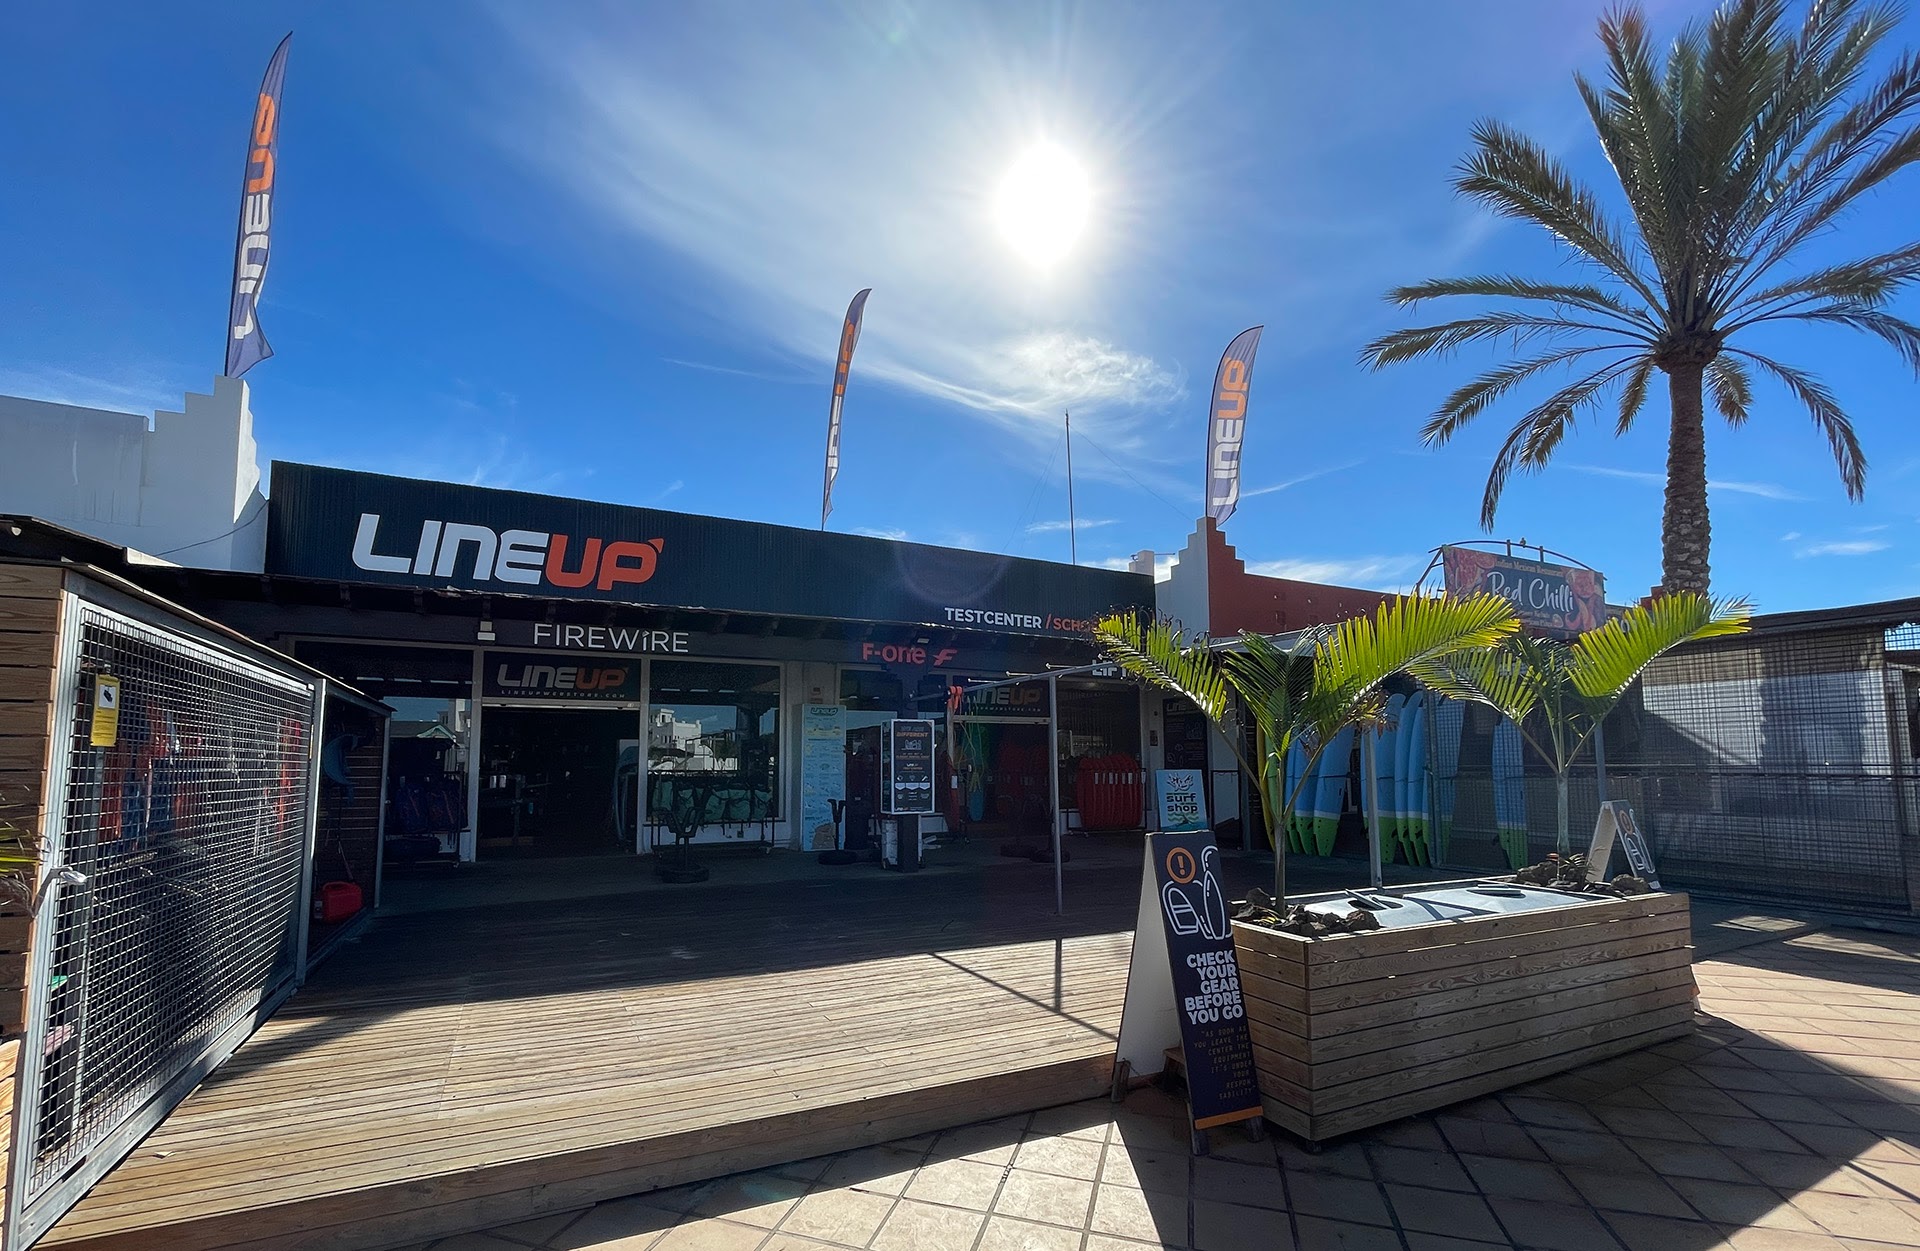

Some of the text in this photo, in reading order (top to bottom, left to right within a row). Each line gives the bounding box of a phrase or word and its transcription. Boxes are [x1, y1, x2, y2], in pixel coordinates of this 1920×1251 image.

[1213, 357, 1247, 506] LINEUP
[352, 513, 664, 591] LINEUP
[1486, 571, 1574, 612] Red Chilli
[944, 607, 1042, 629] TESTCENTER
[497, 664, 629, 690] LINEUP
[501, 690, 625, 698] LINEUPWEBSTORE.COM
[1166, 793, 1196, 802] surf
[1167, 804, 1198, 814] shop
[1186, 950, 1235, 968] CHECK
[1196, 963, 1237, 980] YOUR
[1200, 977, 1239, 994] GEAR
[1184, 991, 1241, 1011] BEFORE
[1187, 1004, 1243, 1025] YOU GO
[1211, 1036, 1231, 1046] LEAVE
[1236, 1033, 1248, 1041] THE
[1218, 1028, 1234, 1036] SOON
[1207, 1042, 1249, 1056] CENTER THE
[1213, 1051, 1250, 1064] EQUIPMENT
[1231, 1059, 1252, 1070] UNDER
[1232, 1069, 1249, 1078] YOUR
